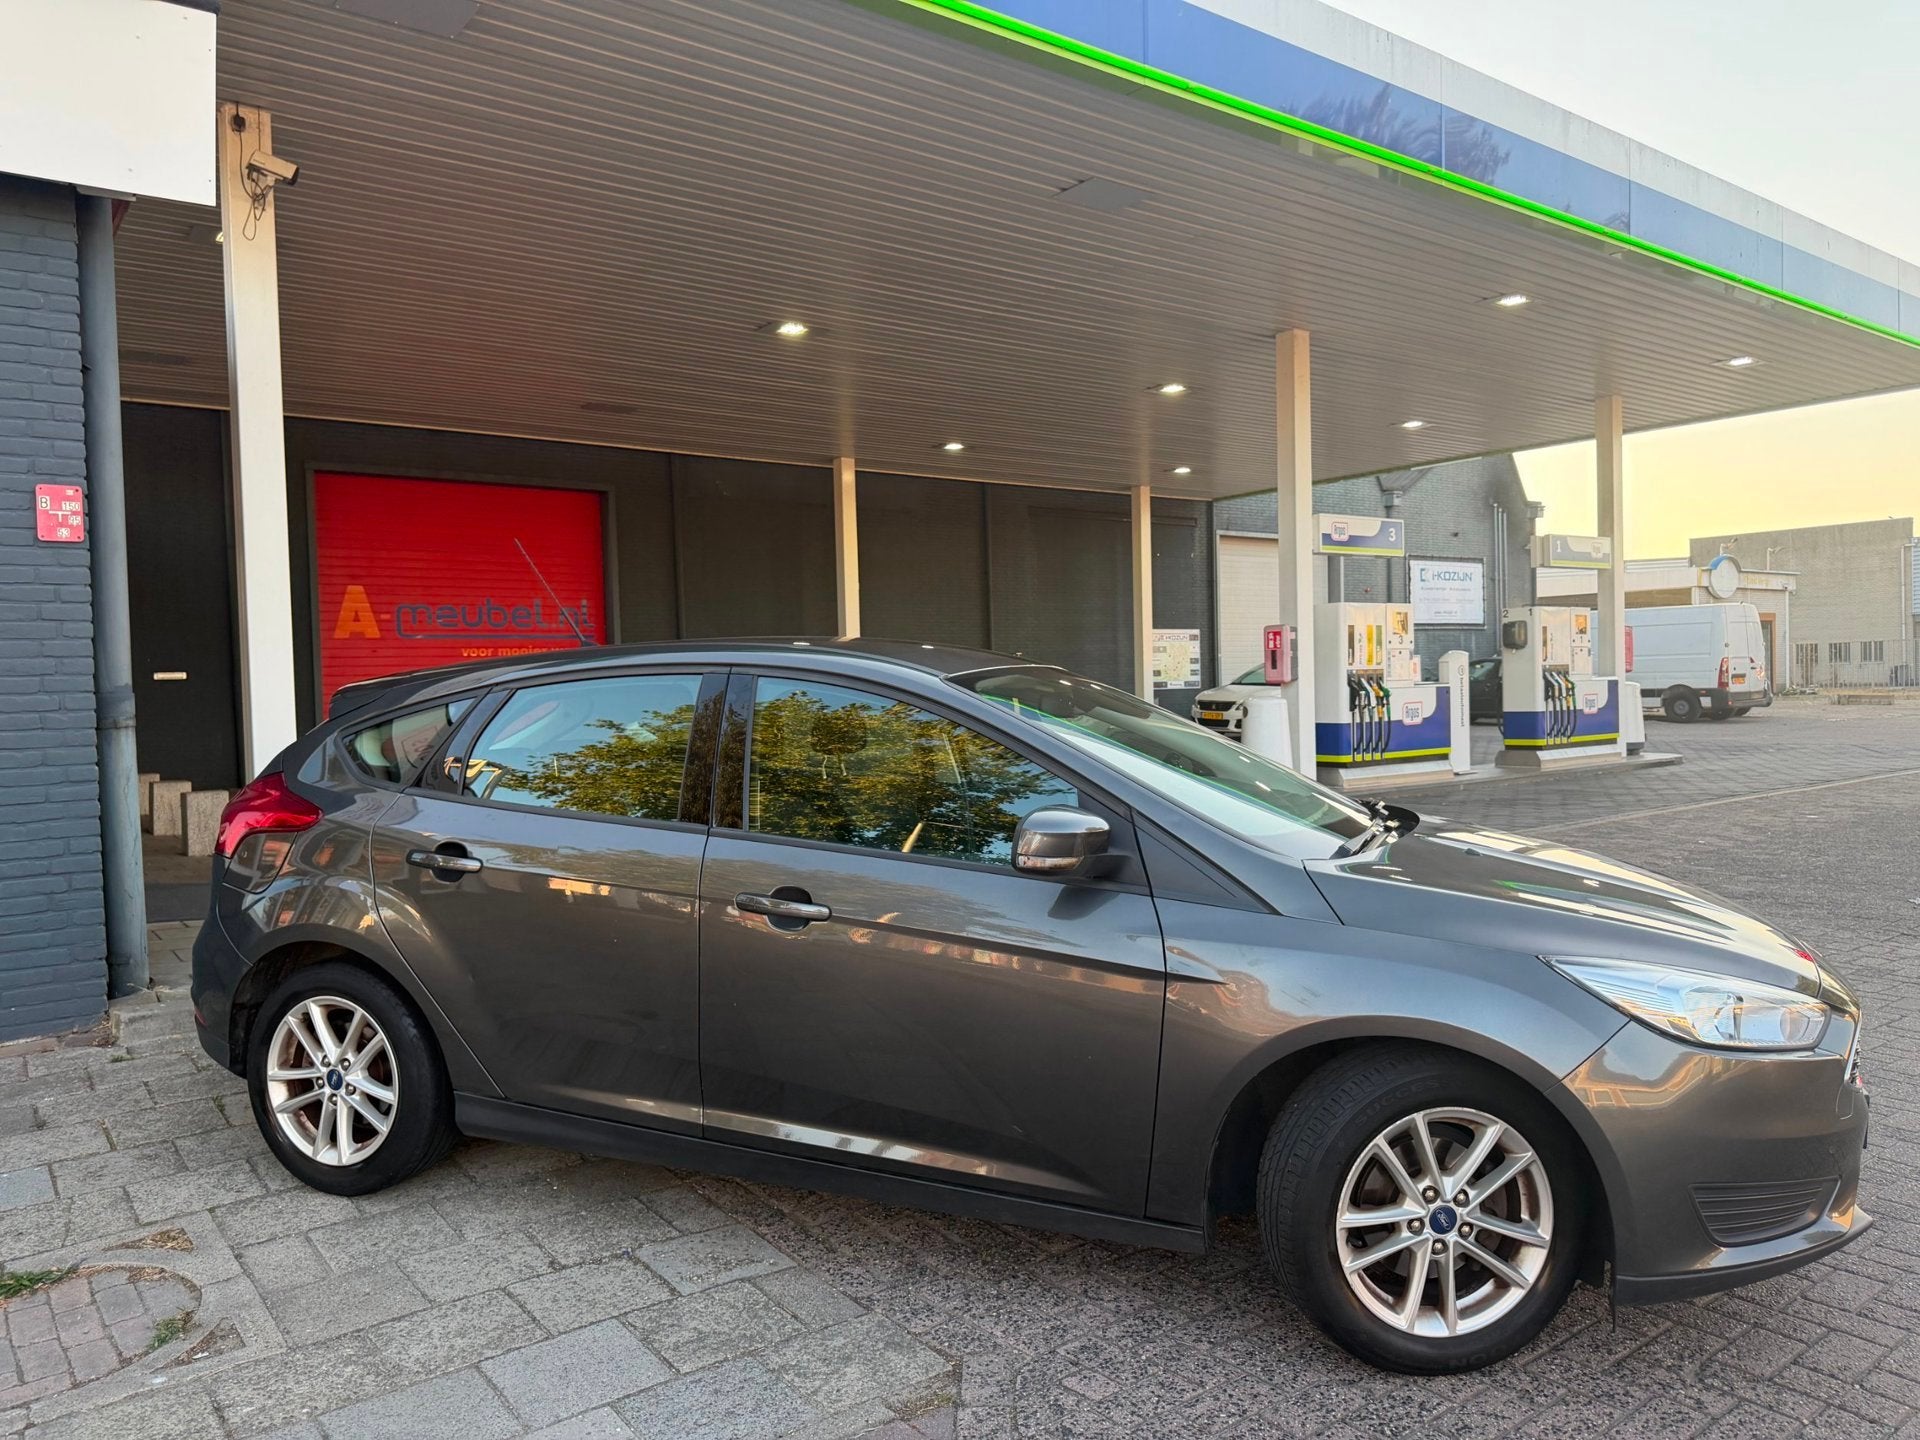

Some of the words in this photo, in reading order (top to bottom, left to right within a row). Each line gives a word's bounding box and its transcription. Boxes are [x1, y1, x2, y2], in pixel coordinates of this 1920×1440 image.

[39, 496, 49, 509] B
[63, 502, 80, 511] 150
[1388, 527, 1396, 542] 3
[1556, 540, 1562, 553] 1
[1502, 609, 1510, 619] 2
[1527, 608, 1533, 617] 1
[461, 647, 494, 658] voor
